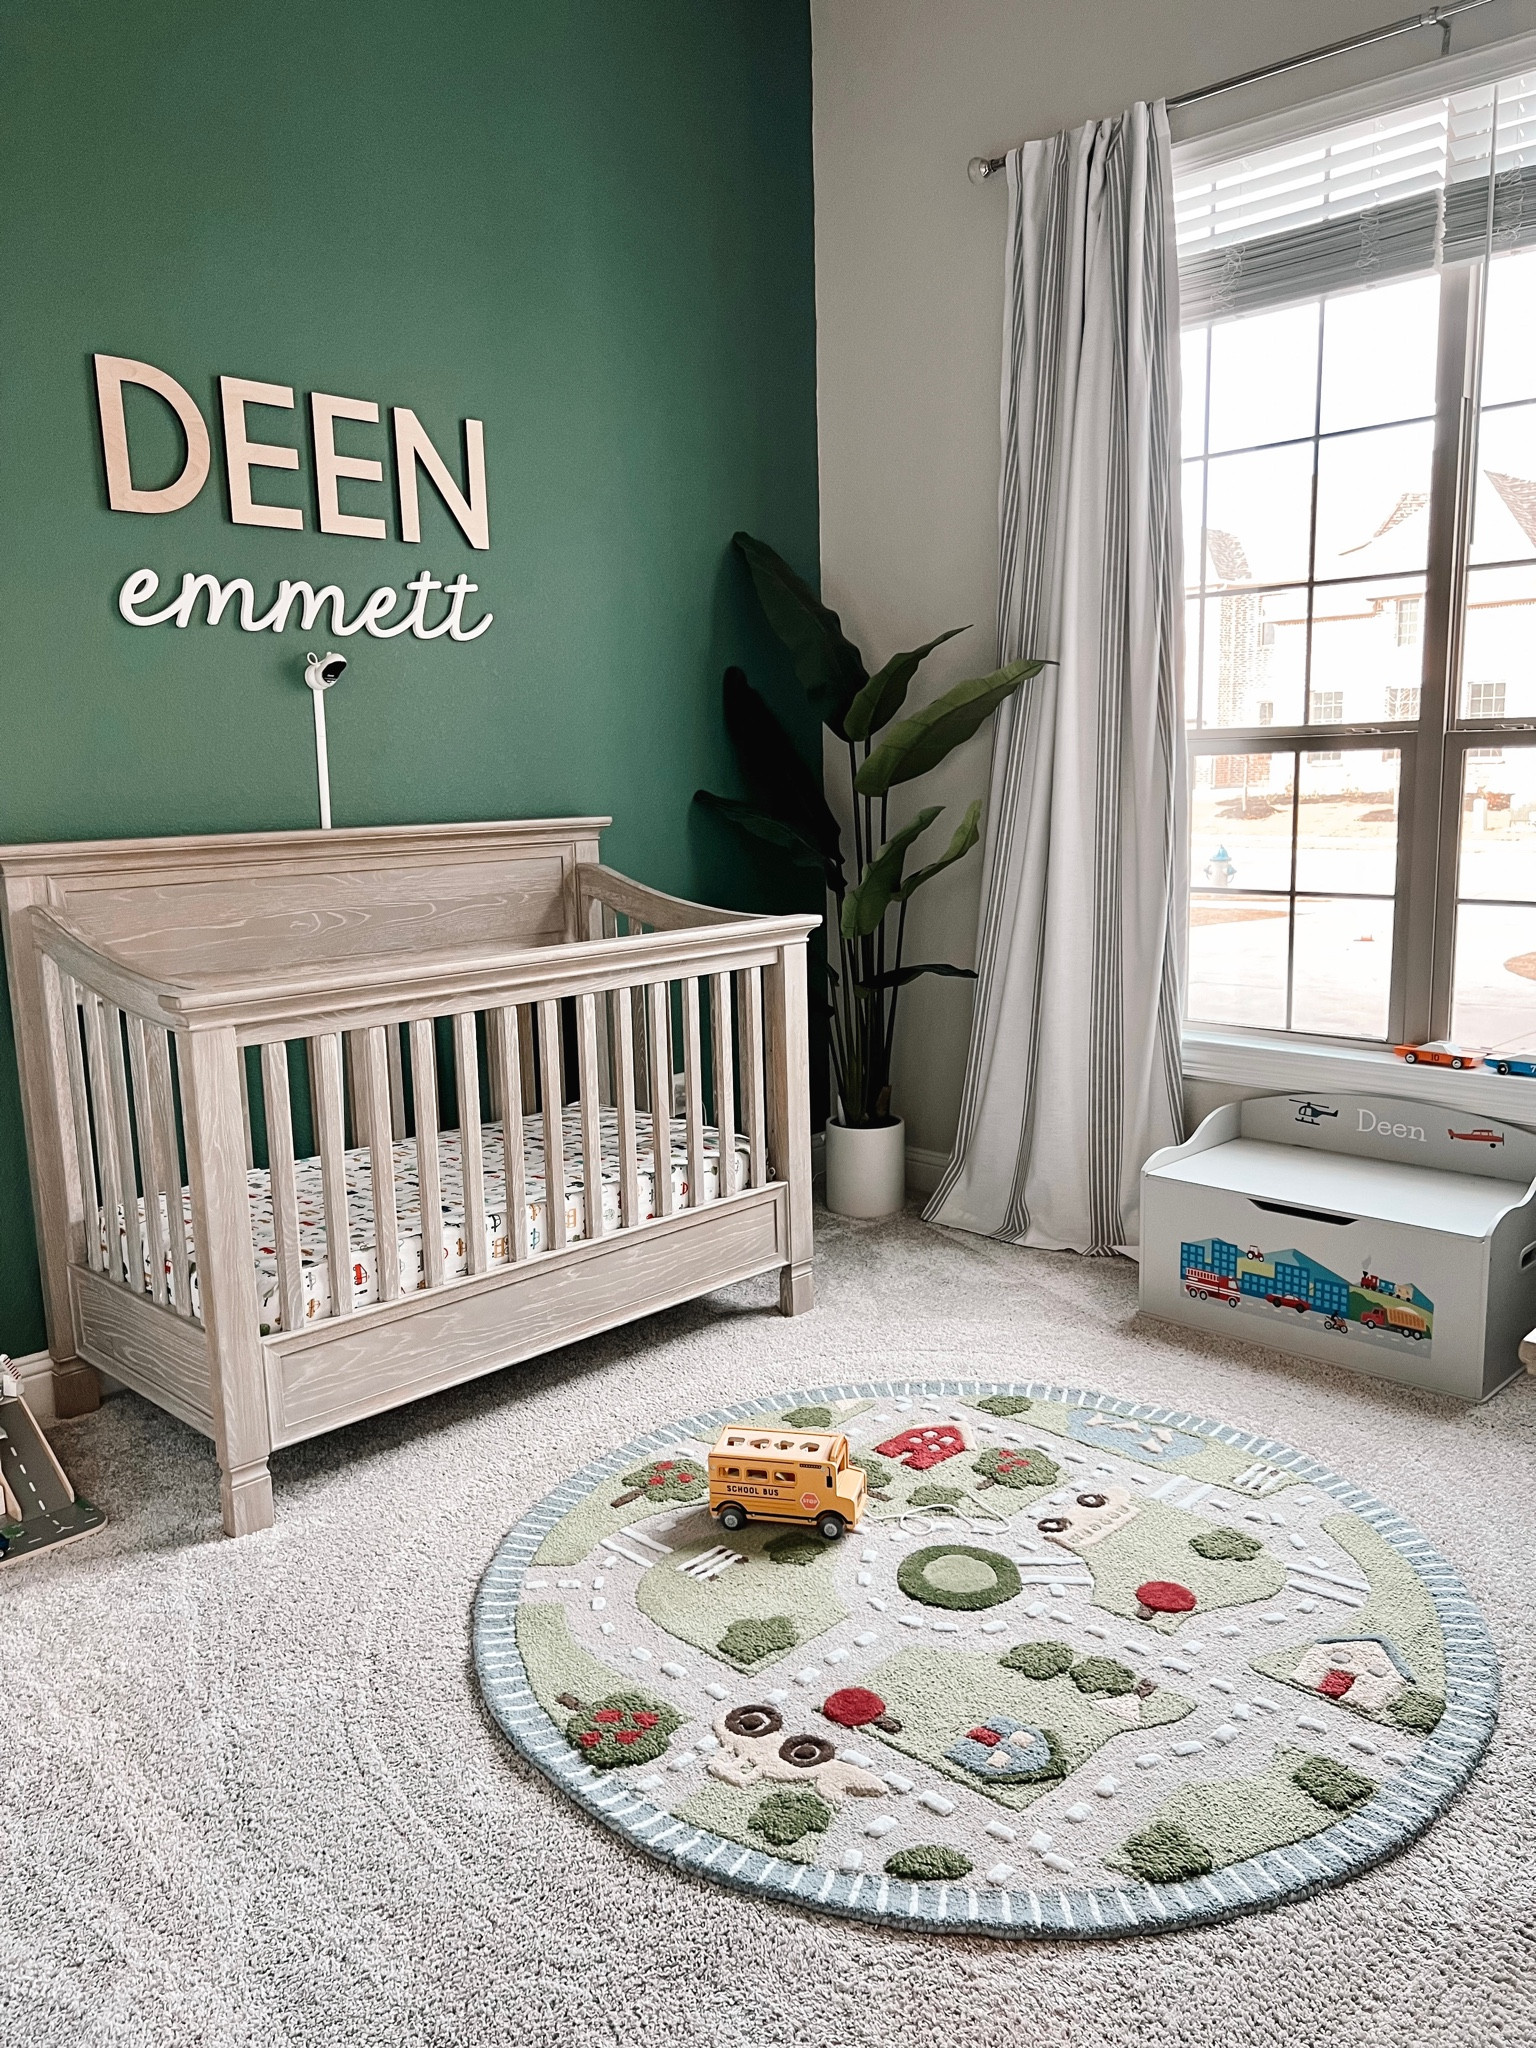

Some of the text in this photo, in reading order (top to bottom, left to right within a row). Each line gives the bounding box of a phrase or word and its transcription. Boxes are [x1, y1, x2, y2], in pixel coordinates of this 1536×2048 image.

[94, 353, 490, 550] DEEN
[119, 568, 494, 642] emmett
[1431, 1053, 1440, 1062] 10
[1356, 1108, 1427, 1142] Deen
[726, 1485, 779, 1496] SCHOOL BUS
